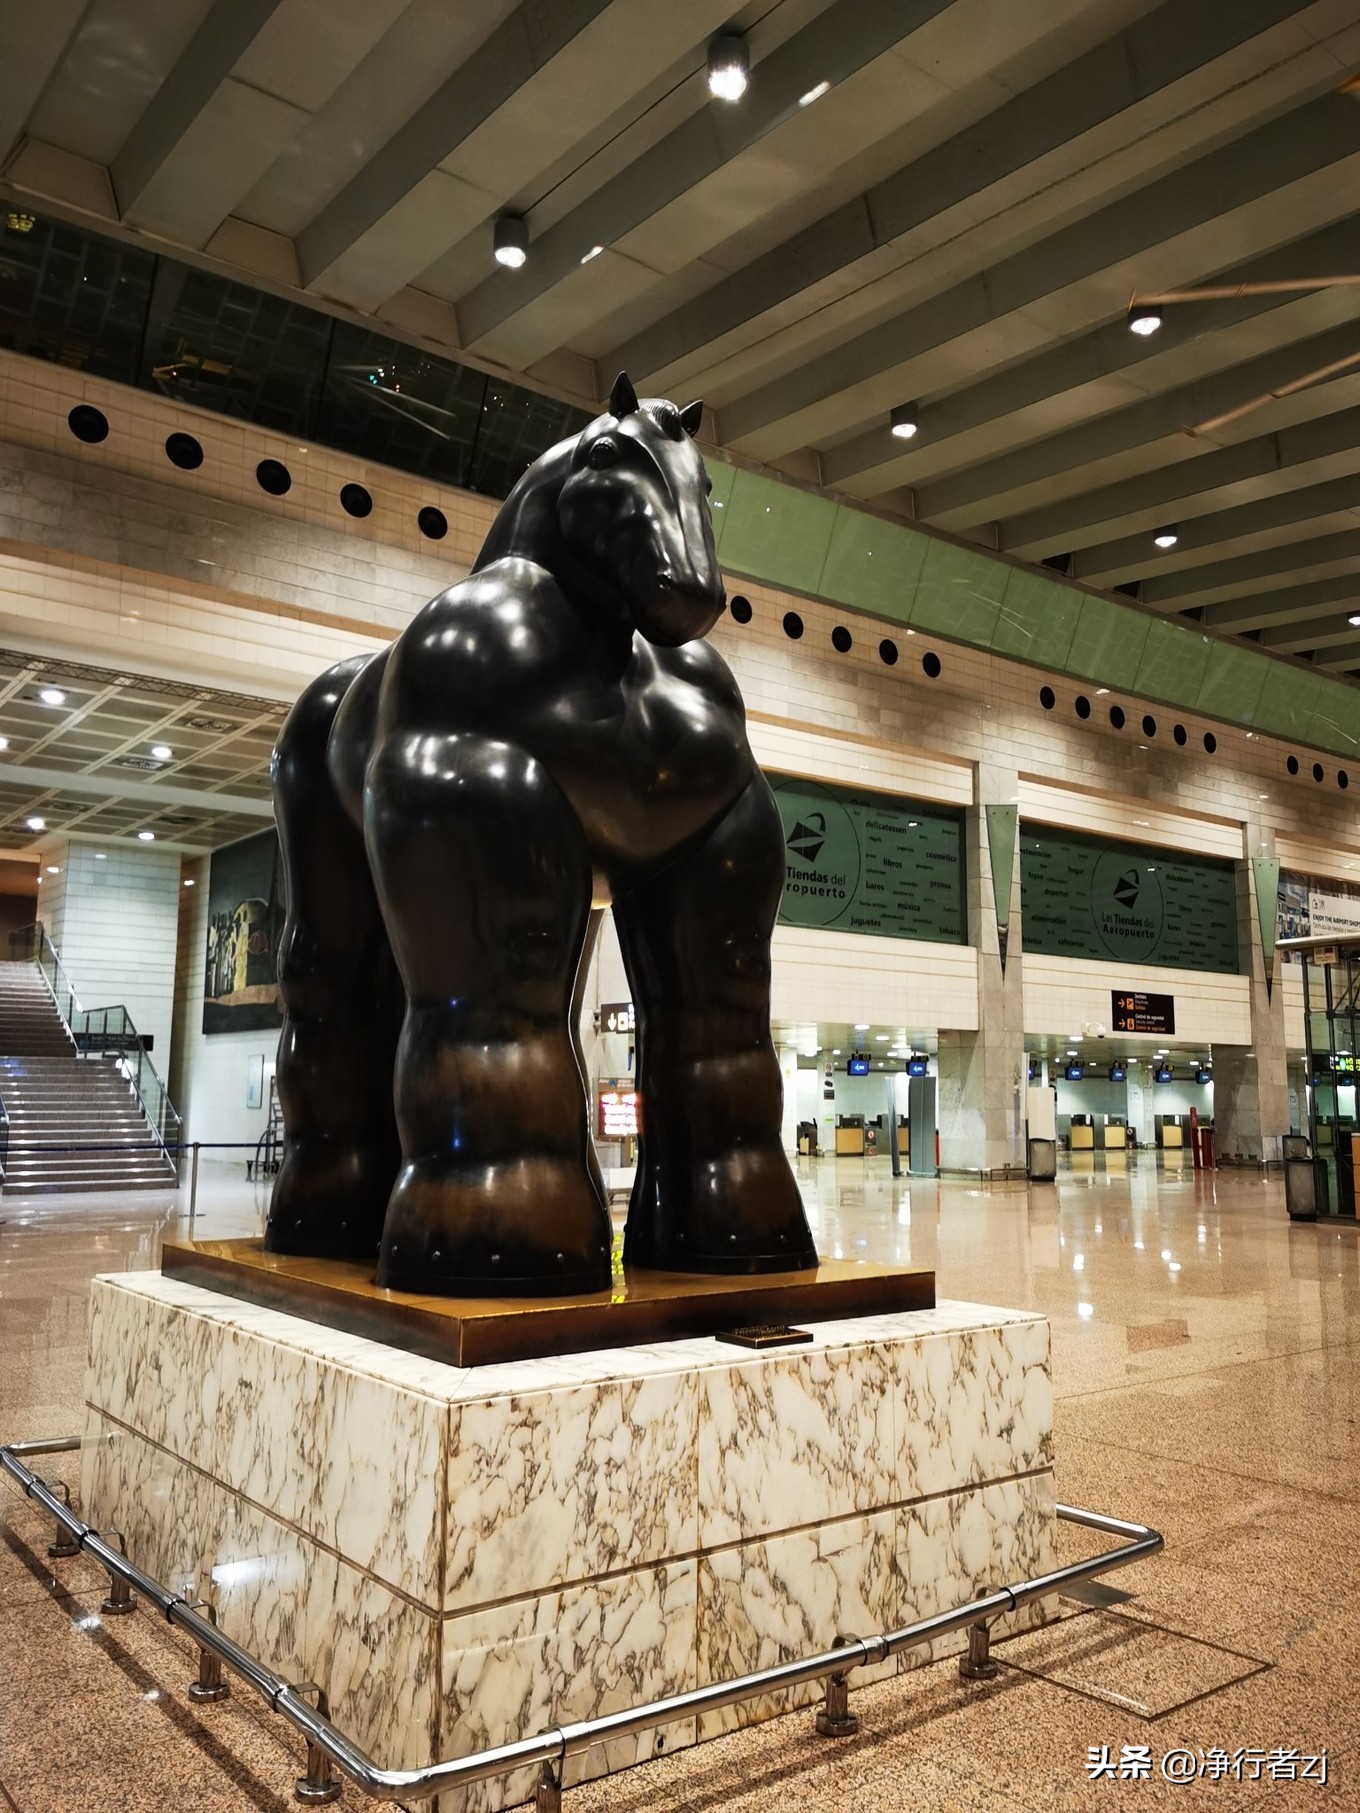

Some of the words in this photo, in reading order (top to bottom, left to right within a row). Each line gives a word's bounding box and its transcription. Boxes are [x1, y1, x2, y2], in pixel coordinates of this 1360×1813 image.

[866, 820, 906, 834] delicatessen
[926, 851, 958, 863] cosmética
[883, 858, 903, 869] libros
[787, 866, 828, 884] Tiendas
[831, 873, 846, 886] del
[786, 881, 846, 899] ropuerto
[865, 881, 885, 891] bares
[929, 881, 951, 890] prensa
[897, 902, 921, 912] música
[850, 915, 881, 927] juguetes
[1102, 911, 1113, 923] Las
[1114, 913, 1143, 927] Tiendas
[1144, 917, 1155, 929] del
[1313, 914, 1325, 922] ENJOY
[1333, 917, 1349, 925] AIRPORT
[939, 926, 961, 936] tabaco
[1103, 924, 1155, 940] Aeropuerto
